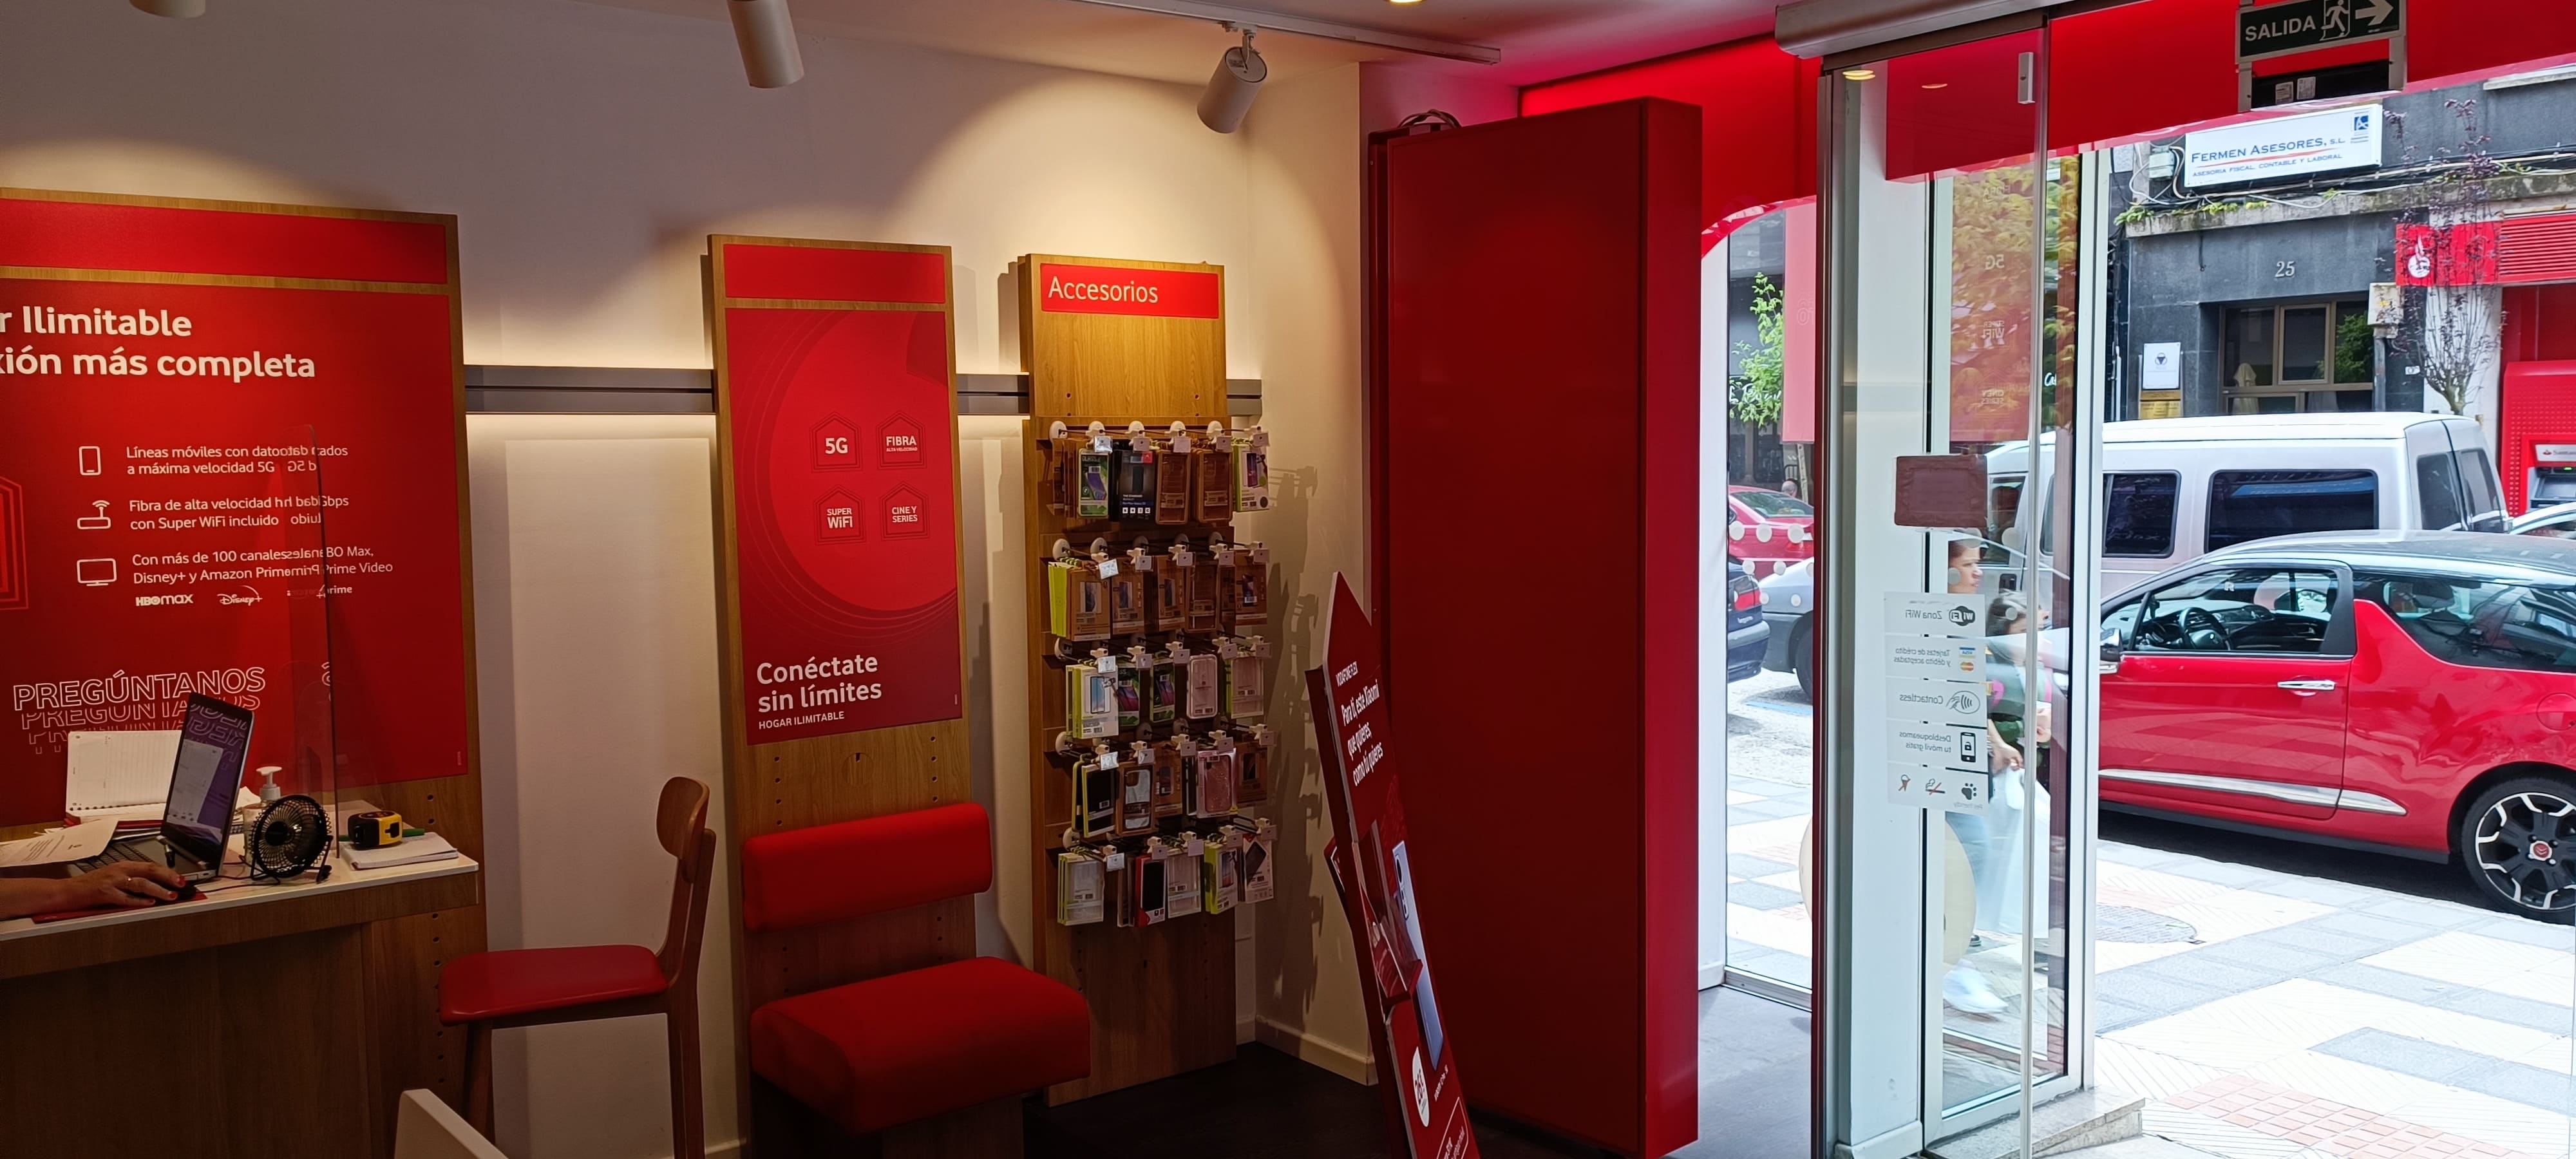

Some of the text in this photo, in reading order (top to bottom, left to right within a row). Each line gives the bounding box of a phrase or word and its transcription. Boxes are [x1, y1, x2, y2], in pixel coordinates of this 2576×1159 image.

[2245, 15, 2316, 42] SALIDA
[2192, 148, 2246, 162] FERMEN
[2251, 138, 2327, 155] ASESORES,
[2259, 160, 2297, 169] CONTABLE
[2307, 154, 2343, 162] LABORAL
[2275, 261, 2295, 278] 25
[1048, 276, 1159, 304] Accesorios
[23, 305, 193, 337] Ilimitable
[72, 346, 147, 375] más
[157, 351, 316, 383] completa
[825, 437, 848, 455] 5G
[886, 435, 917, 446] FIBRA
[126, 446, 169, 458] Líneas
[172, 446, 222, 458] móviles
[225, 448, 249, 457] con
[127, 462, 275, 475] a máxima velocidad 5G
[129, 500, 161, 512] Fibra
[165, 499, 182, 510] de
[185, 498, 208, 510] alta
[211, 496, 271, 509] velocidad
[827, 507, 852, 516] SUPER
[892, 506, 910, 514] CINE
[130, 514, 279, 531] con Super WiFi incluido
[892, 514, 918, 523] SERIES
[132, 554, 158, 565] Con
[162, 552, 189, 564] más
[193, 552, 209, 563] de
[213, 551, 237, 561] 100
[347, 546, 374, 557] Max,
[133, 572, 185, 585] Disney+
[189, 572, 197, 584] y
[200, 569, 252, 581] Amazon
[359, 562, 393, 574] Video
[216, 585, 263, 607] Disney+
[757, 654, 878, 685] Conéctate
[13, 666, 266, 711] PREGÚNTANOS
[758, 683, 882, 713] sin límites
[1356, 692, 1366, 715] este
[758, 711, 845, 730] HOGAR ILIMITABLE
[1353, 761, 1365, 787] como
[1368, 742, 1383, 773] quieres
